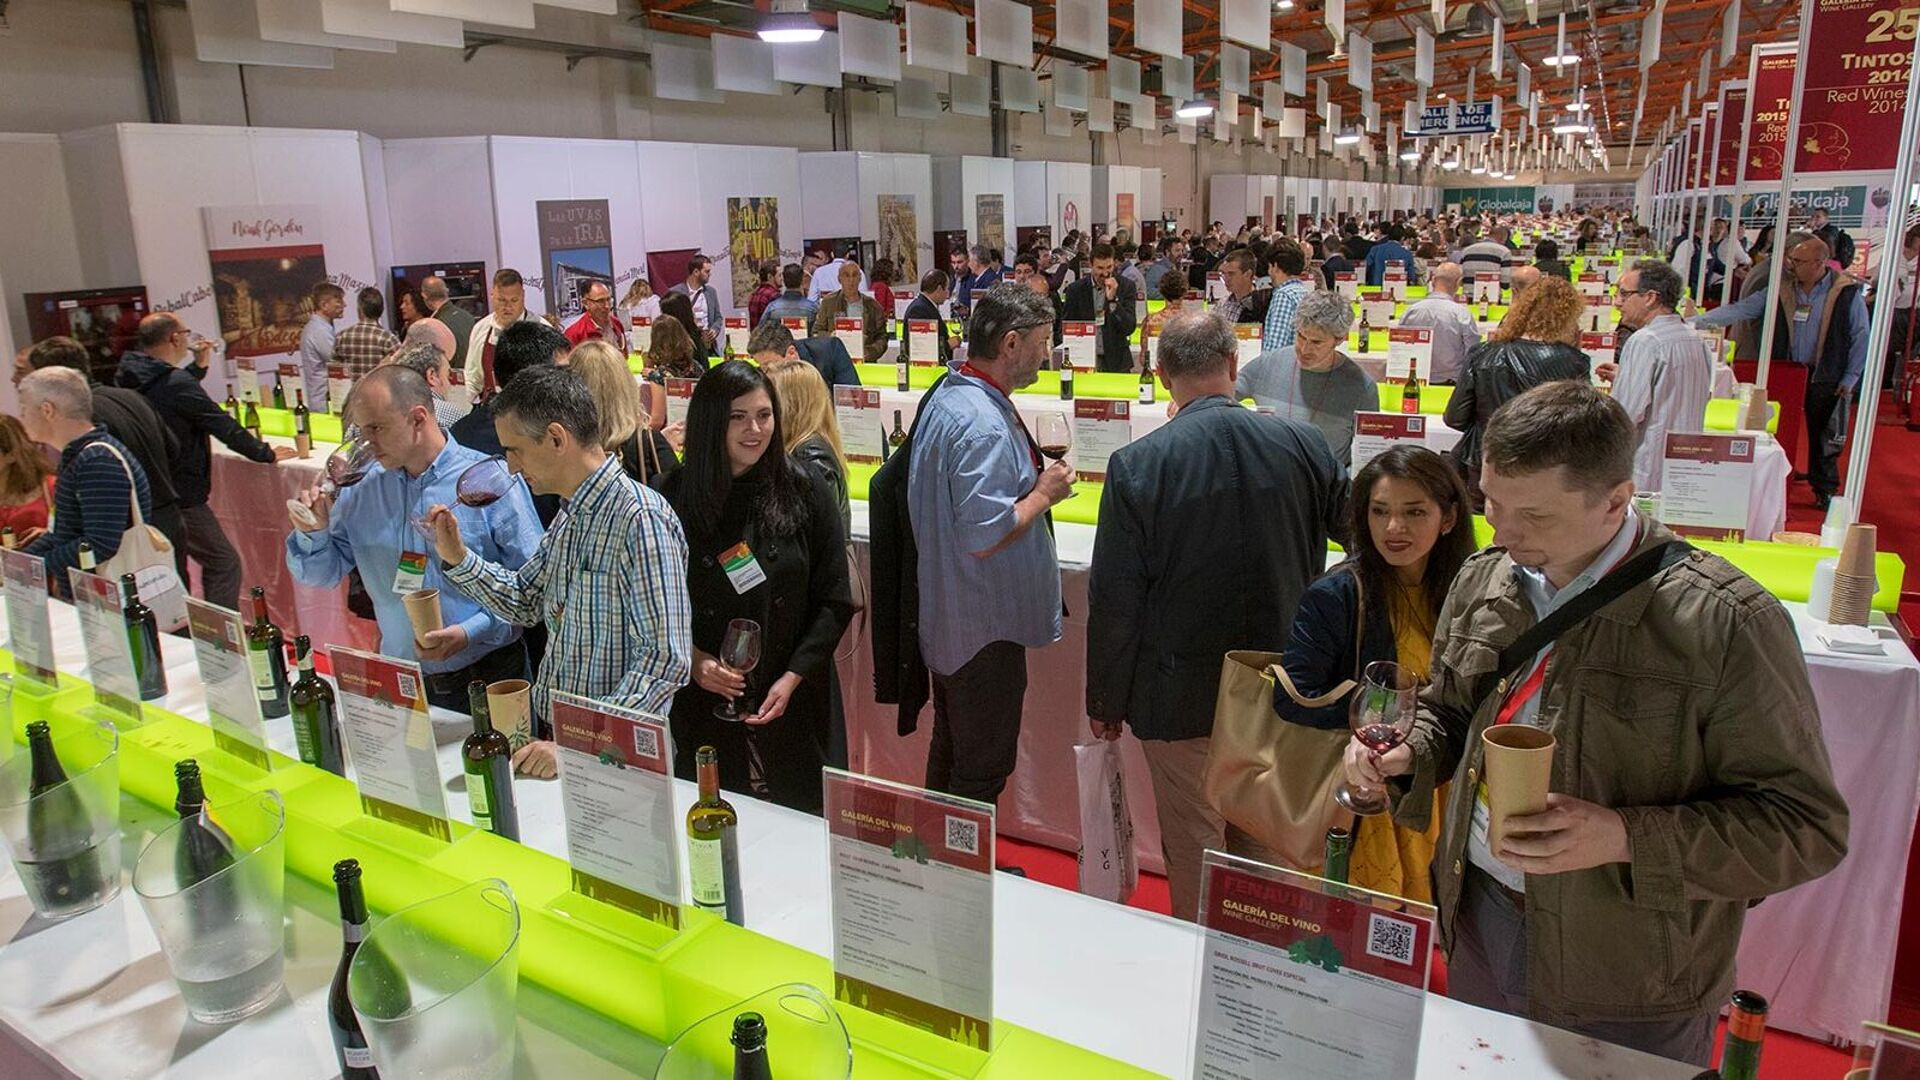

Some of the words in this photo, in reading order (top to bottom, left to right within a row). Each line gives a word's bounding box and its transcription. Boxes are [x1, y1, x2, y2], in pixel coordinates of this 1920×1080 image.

[1842, 3, 1874, 11] GALLERY
[1864, 8, 1919, 43] 25
[1868, 69, 1911, 84] 2014
[1828, 88, 1858, 104] Red
[1466, 104, 1485, 115] DE
[1868, 100, 1908, 114] 2014
[1420, 114, 1492, 128] ERGENCIA
[1757, 111, 1788, 122] 2015
[1759, 132, 1787, 143] 2015
[1479, 199, 1532, 211] Globalcaja
[567, 207, 602, 222] UVAS
[263, 218, 304, 242] Gordon
[574, 223, 607, 244] IRA
[841, 808, 875, 825] GALERÍA
[875, 818, 891, 829] DEL
[891, 822, 913, 834] VINO
[1222, 899, 1268, 920] GALERÍA
[1269, 912, 1291, 926] DEL
[1292, 917, 1321, 933] VINO
[1222, 907, 1242, 920] WINE
[1244, 914, 1283, 931] GALLERY
